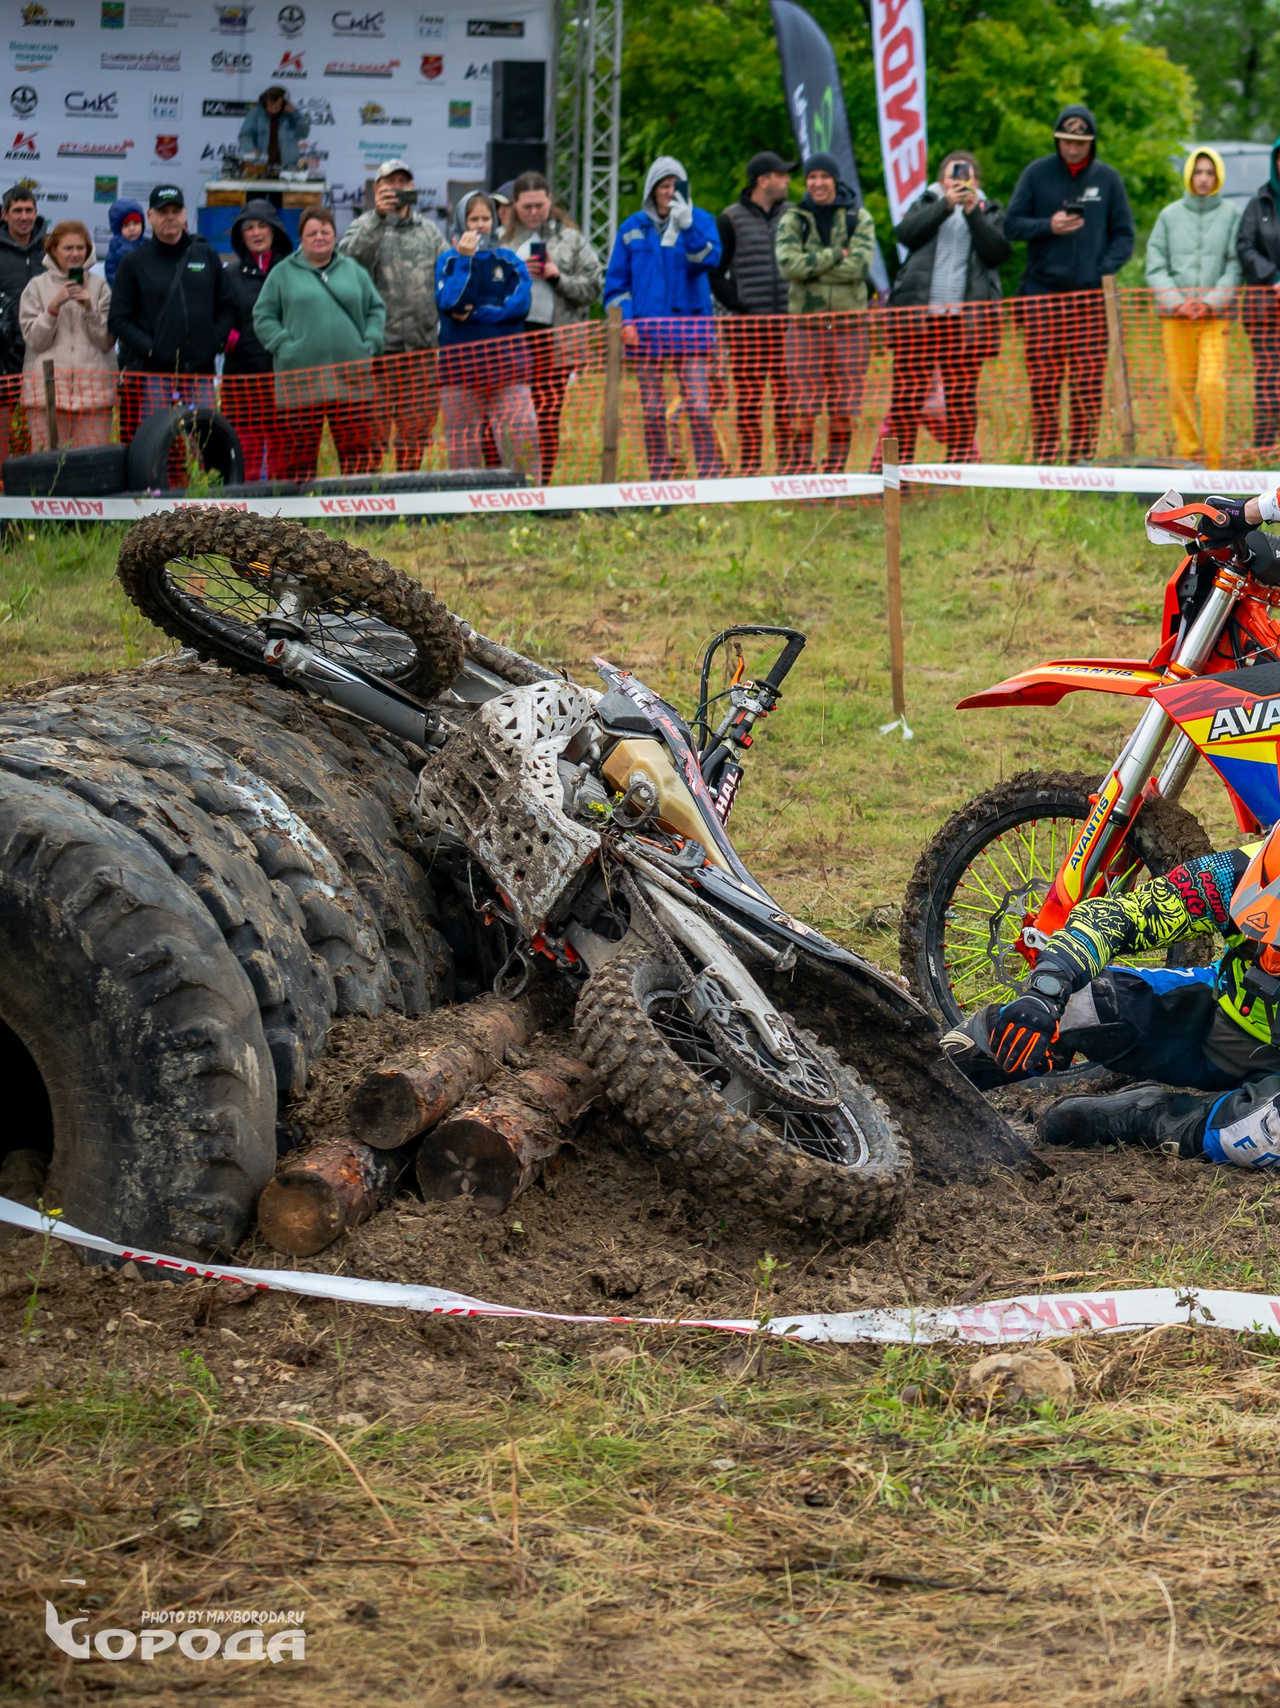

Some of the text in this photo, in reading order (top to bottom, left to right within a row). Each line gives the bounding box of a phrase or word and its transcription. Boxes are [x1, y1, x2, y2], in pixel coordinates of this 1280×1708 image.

[1051, 665, 1136, 679] AVANTIS
[1069, 795, 1110, 871] AVANTIS
[1198, 870, 1229, 924] RACING
